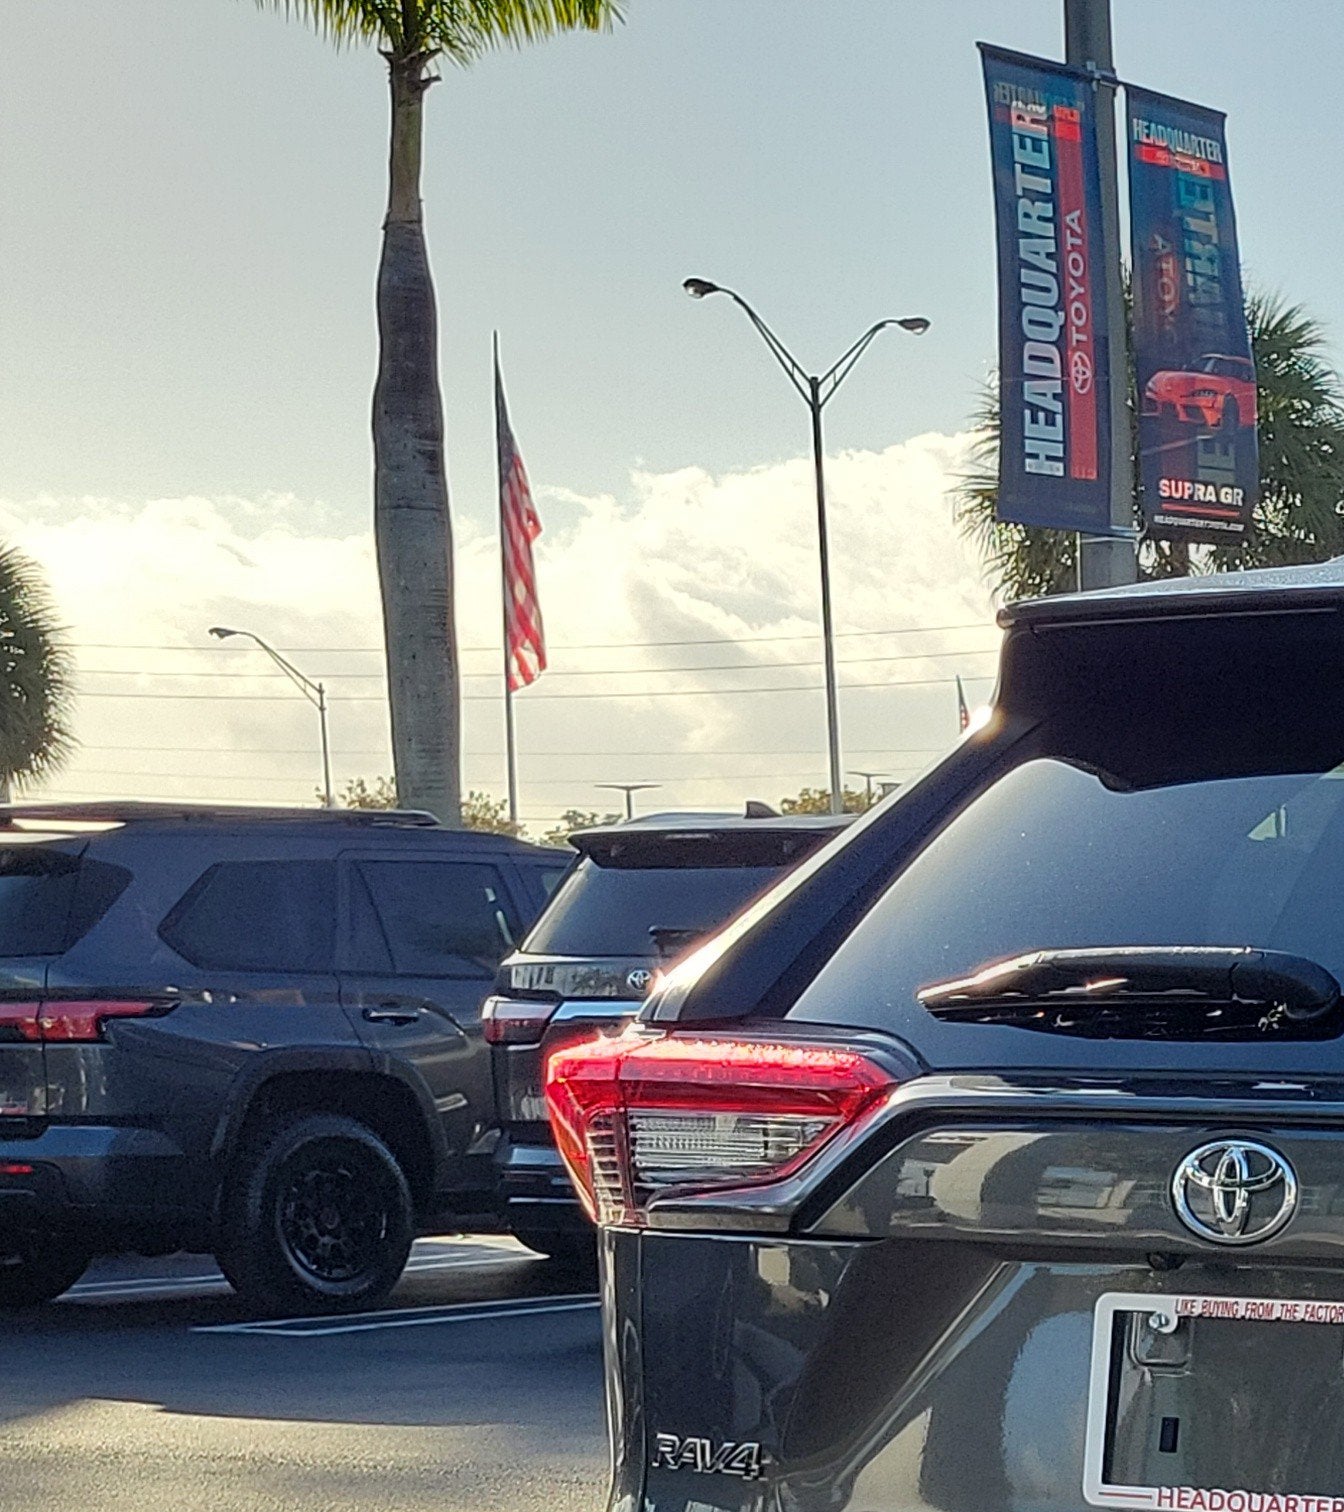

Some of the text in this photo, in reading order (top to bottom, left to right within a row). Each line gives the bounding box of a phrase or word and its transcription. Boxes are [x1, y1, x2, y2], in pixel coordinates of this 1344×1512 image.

[1132, 118, 1222, 163] HEADQUARTER
[1011, 102, 1067, 476] HEADQUARTER
[1065, 209, 1089, 346] TOYOTA
[1159, 479, 1244, 506] SUPRA GR
[1174, 1297, 1197, 1315] LIKE
[1201, 1299, 1239, 1317] BUYING
[1244, 1302, 1275, 1319] FROM
[1280, 1303, 1301, 1320] THE
[652, 1432, 761, 1481] RAV4
